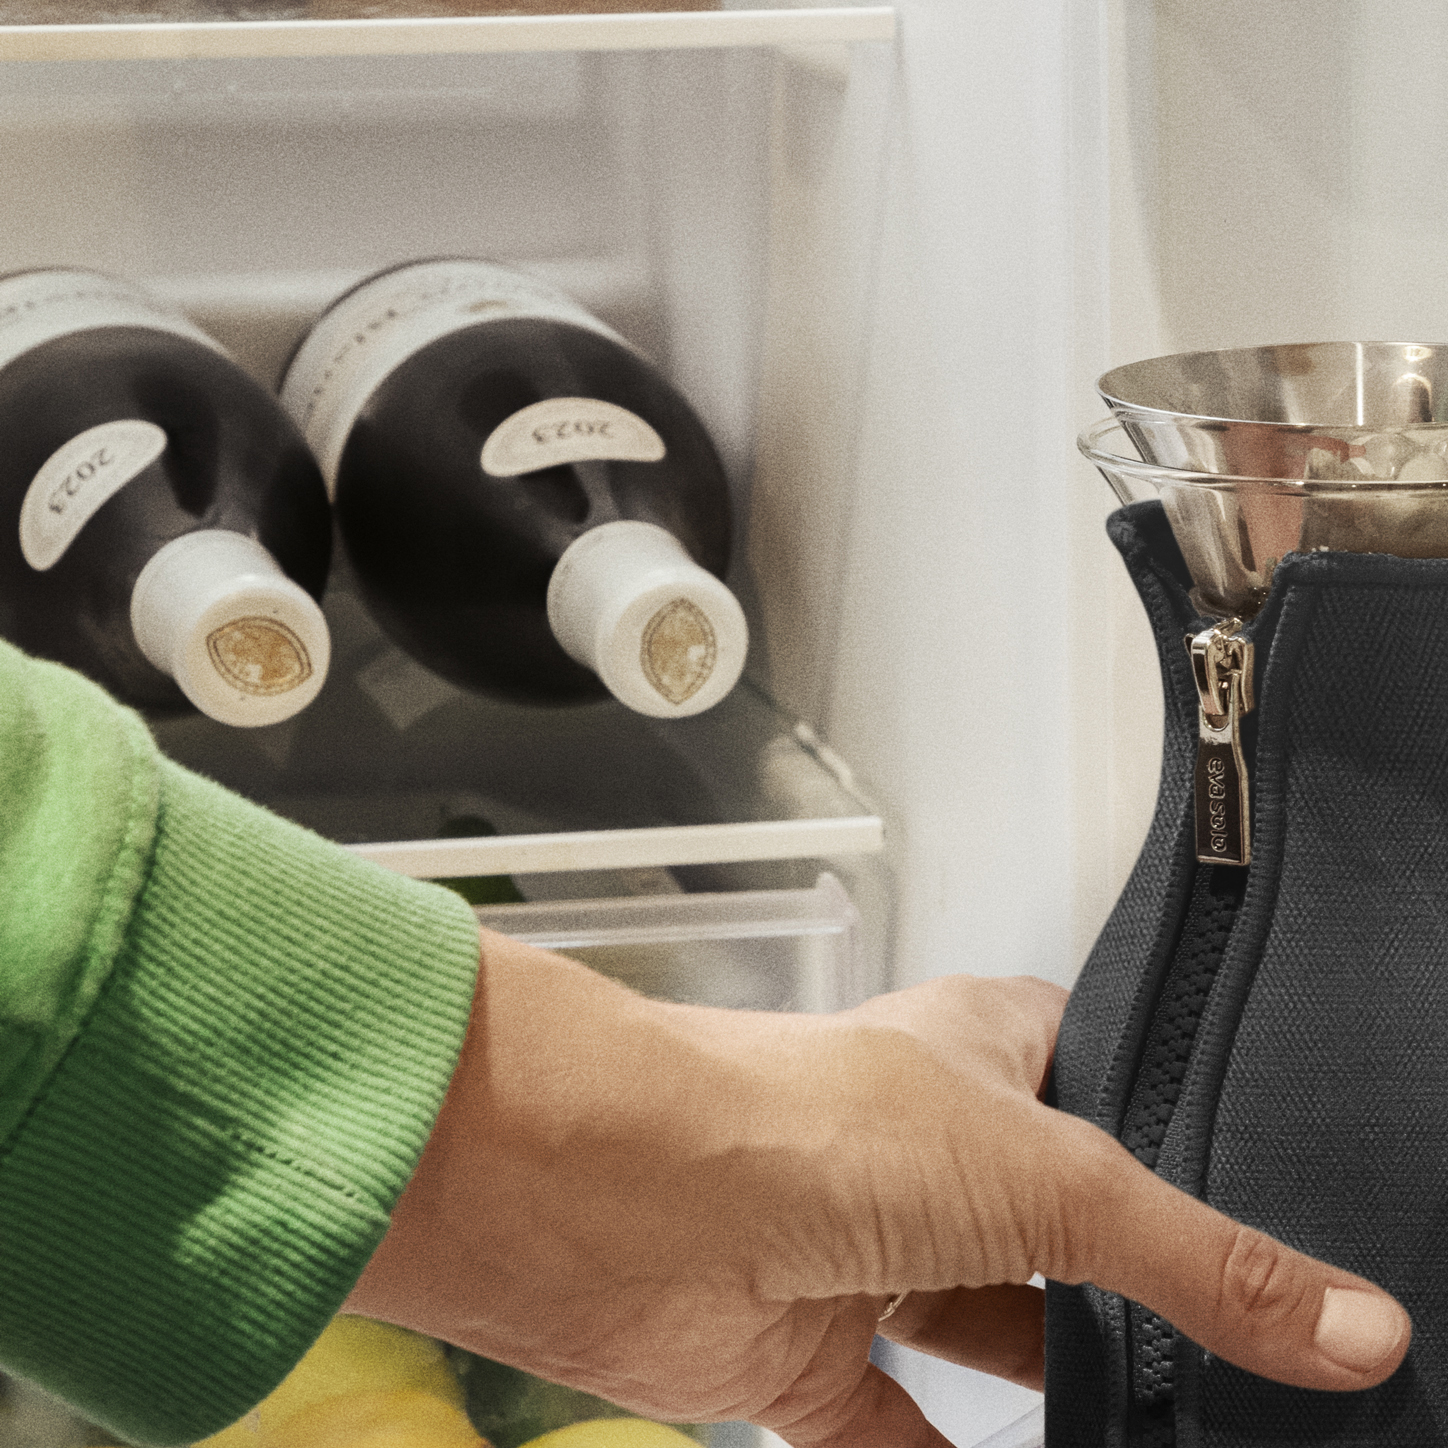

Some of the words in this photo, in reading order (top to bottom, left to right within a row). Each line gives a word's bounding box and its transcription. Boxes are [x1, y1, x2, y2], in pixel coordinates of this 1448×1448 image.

[530, 419, 615, 446] 2023
[47, 446, 115, 517] 2023
[1207, 756, 1226, 800] eva
[1209, 801, 1229, 853] solo
